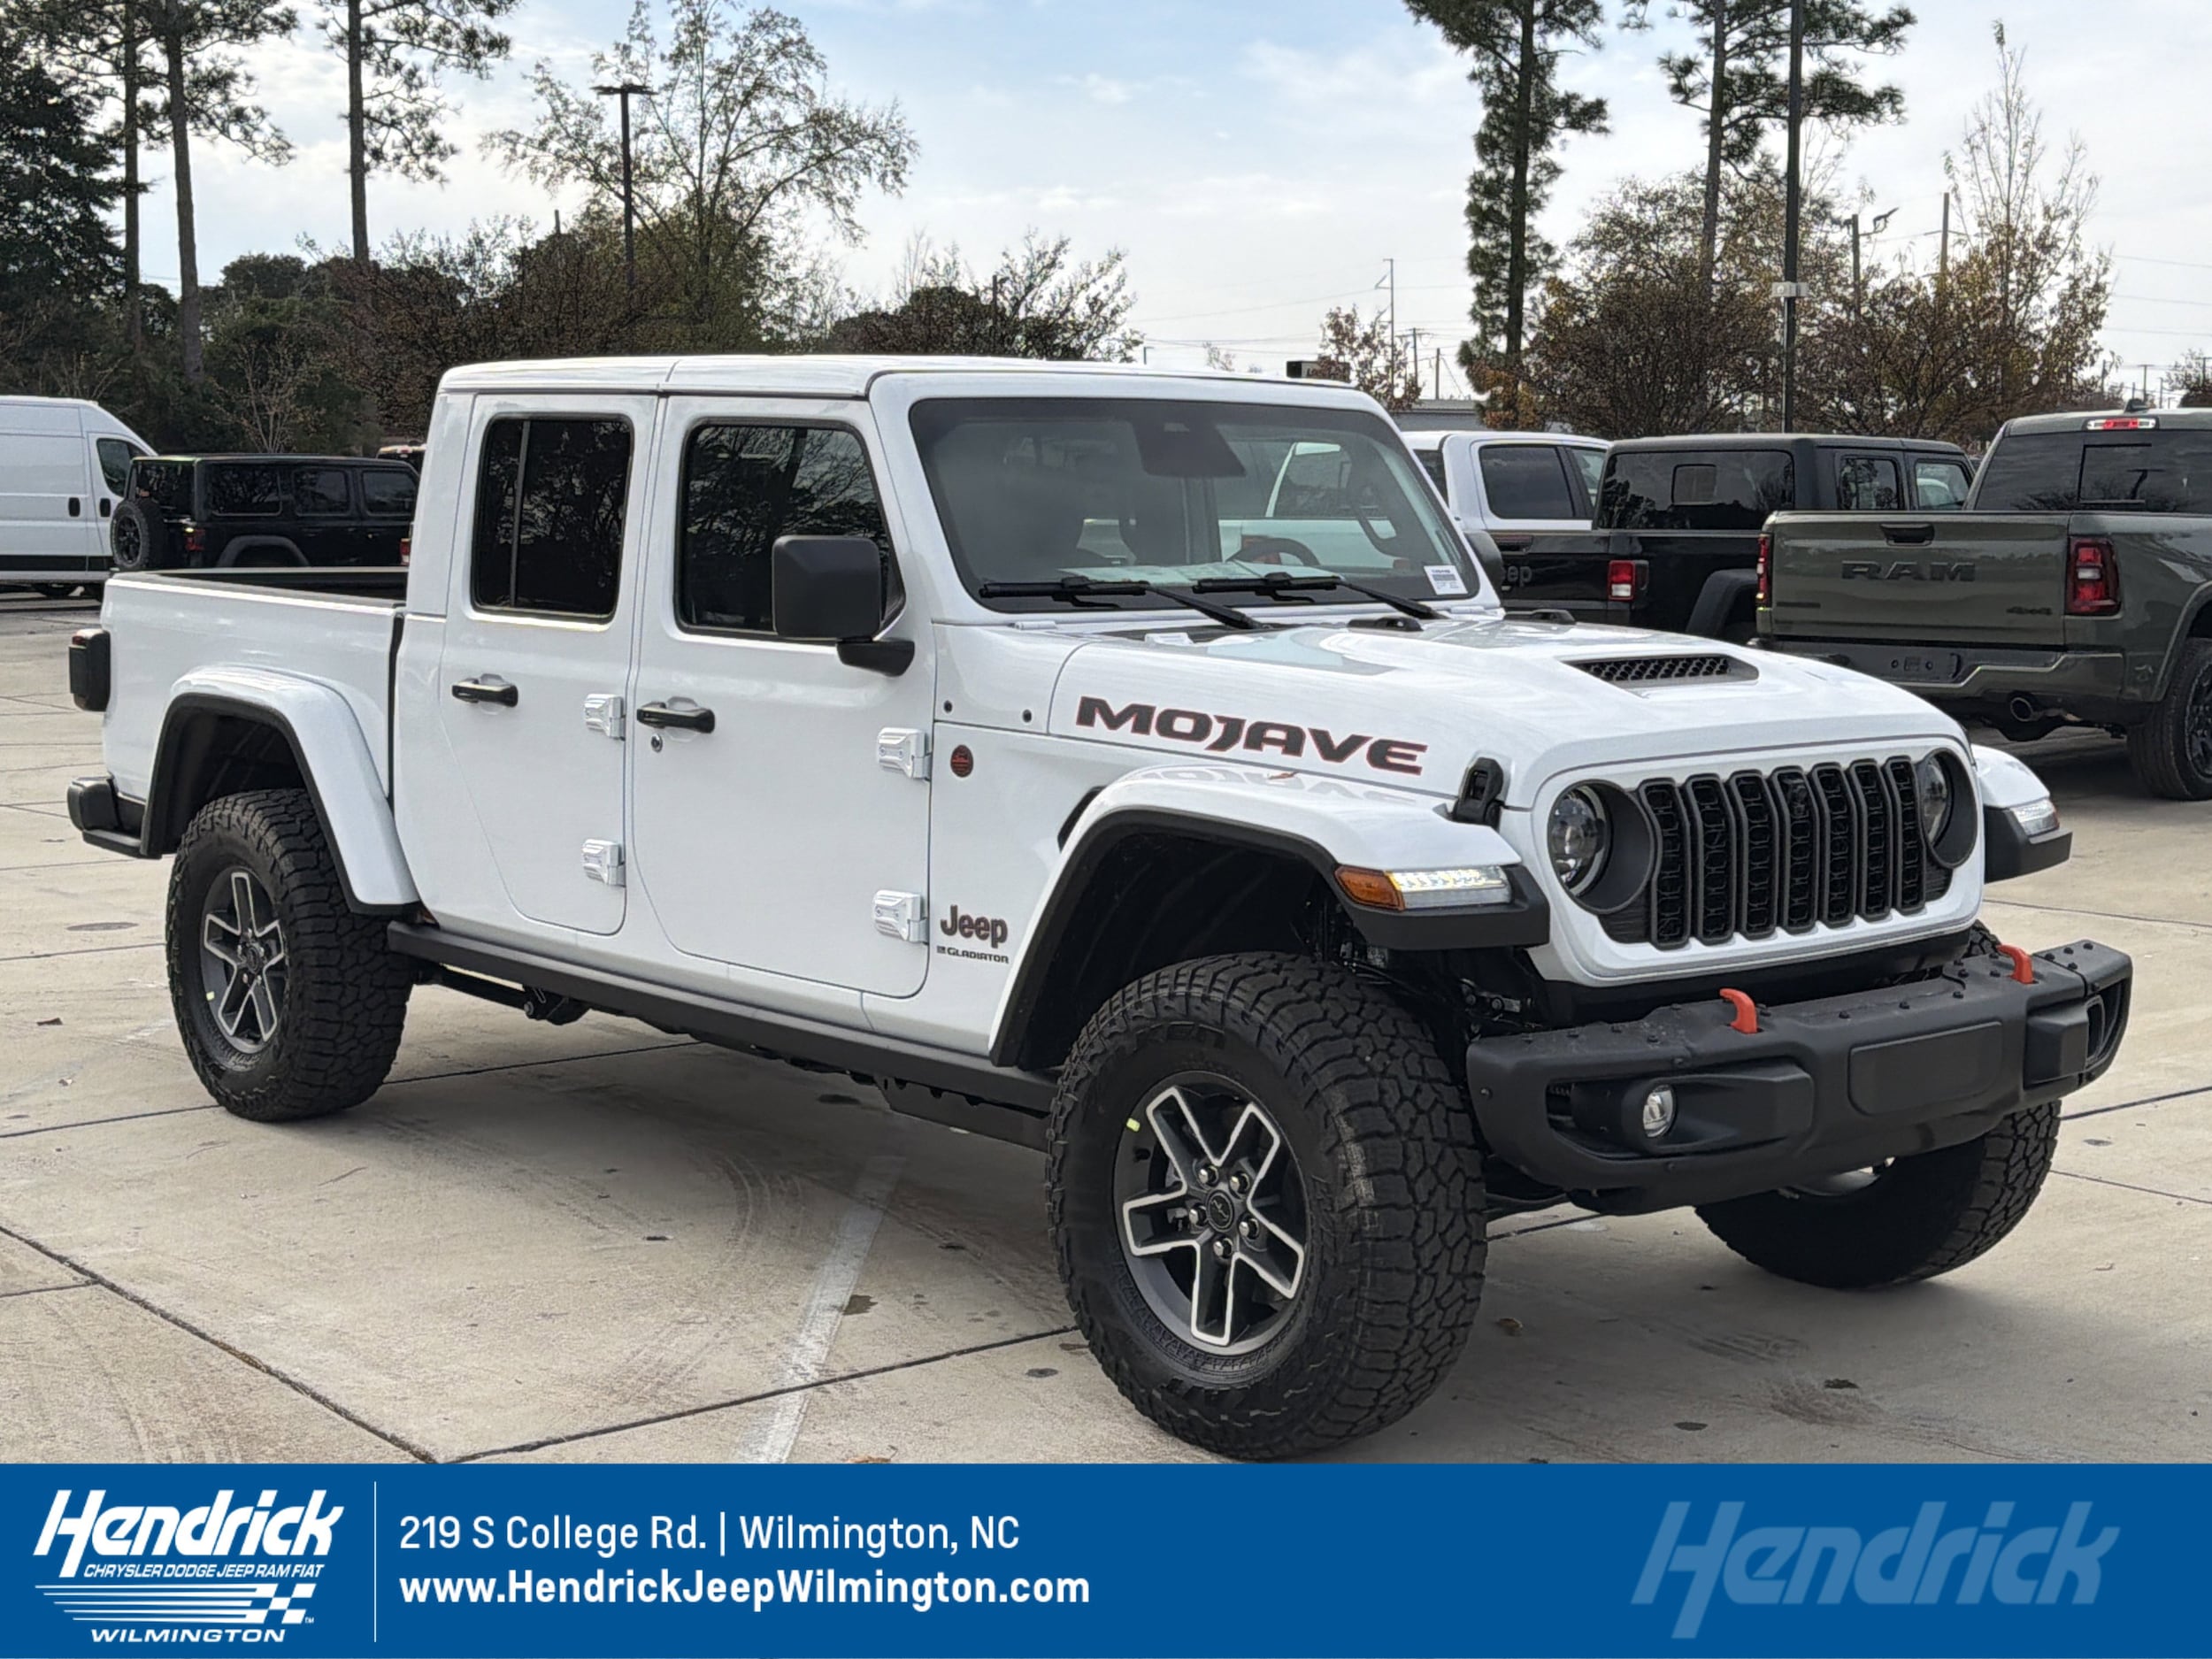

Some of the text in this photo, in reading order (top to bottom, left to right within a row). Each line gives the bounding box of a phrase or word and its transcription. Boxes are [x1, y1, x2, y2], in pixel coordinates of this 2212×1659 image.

[1841, 560, 1976, 582] RAM
[1076, 695, 1428, 776] MOJAVE
[940, 903, 1008, 949] Jeep
[947, 947, 1009, 964] GLADIATOR
